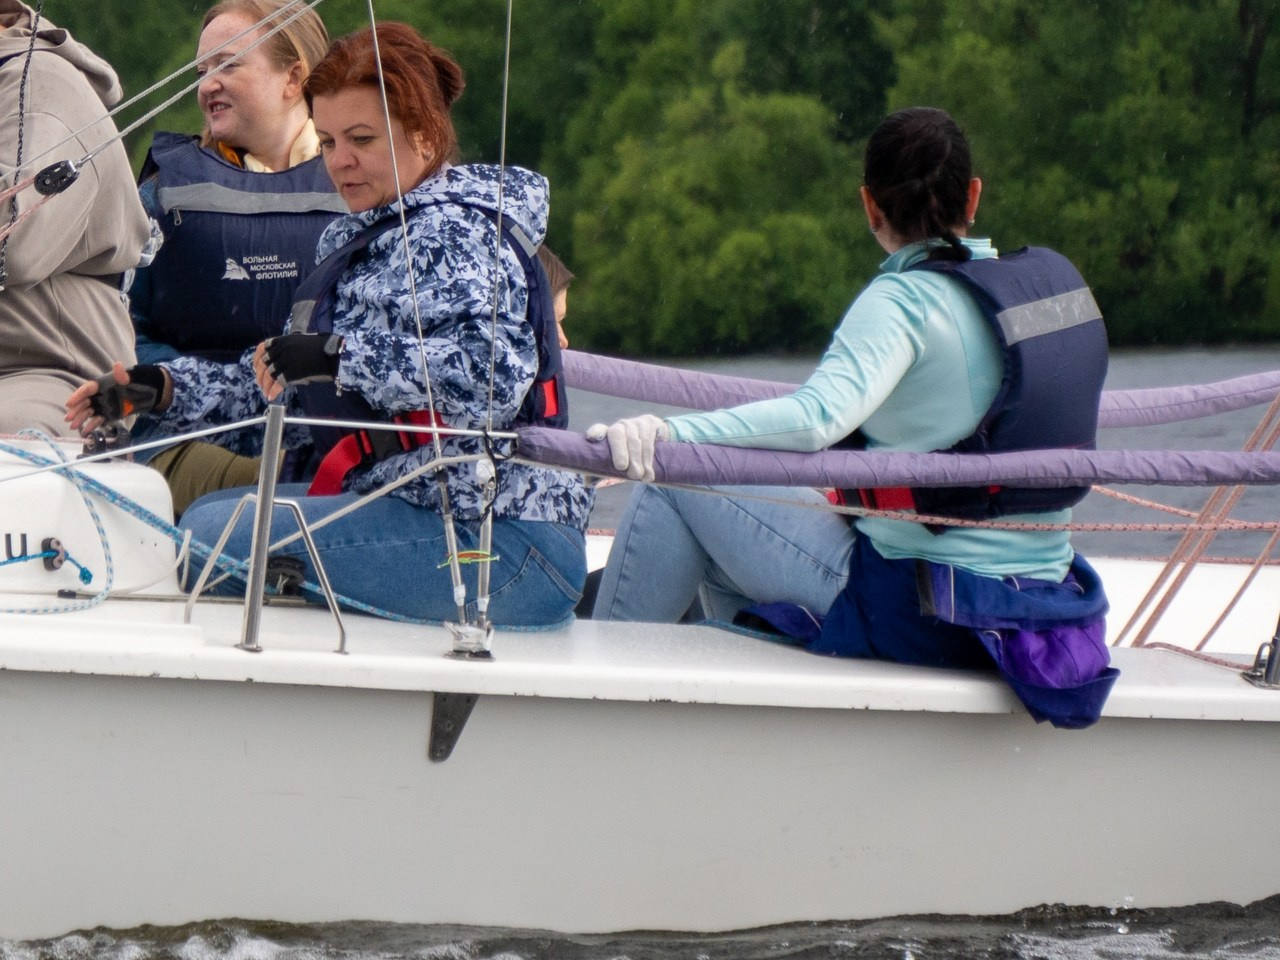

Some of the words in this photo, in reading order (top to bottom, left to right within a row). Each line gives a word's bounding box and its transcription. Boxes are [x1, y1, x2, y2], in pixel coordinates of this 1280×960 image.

[242, 255, 278, 264] ВОЛЬНАЯ
[250, 262, 296, 271] МОСКОВСКАЯ
[256, 270, 298, 280] ФЛОТИЛИЯ
